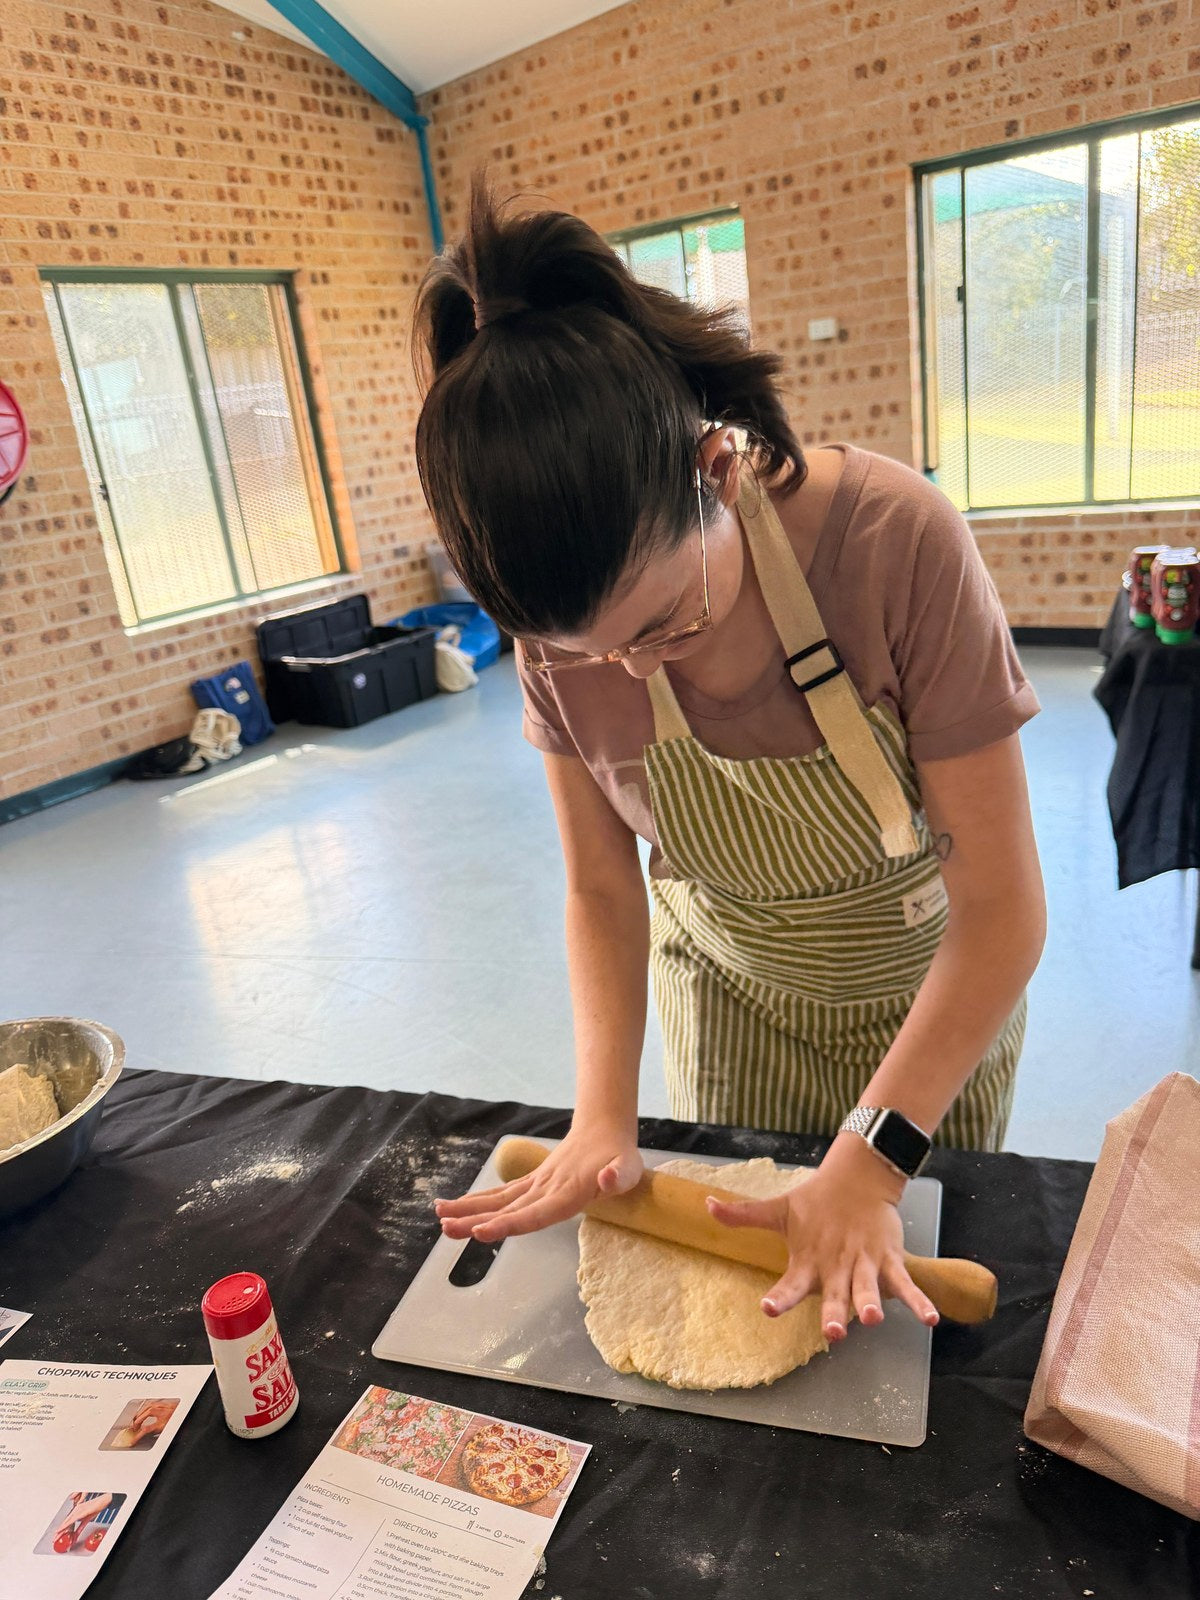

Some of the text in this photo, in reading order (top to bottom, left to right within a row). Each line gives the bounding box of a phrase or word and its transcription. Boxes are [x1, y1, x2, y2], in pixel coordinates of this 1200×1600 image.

[37, 1367, 178, 1381] CHOPPING TECHNIQUES
[304, 1483, 351, 1505] INGREDIENTS
[376, 1475, 481, 1516] HOMEMADE PIZZAS
[333, 1531, 353, 1541] yoghurt
[393, 1518, 438, 1539] DIRECTIONS
[384, 1542, 397, 1550] with
[396, 1546, 415, 1558] baking
[410, 1539, 424, 1549] oven
[469, 1560, 490, 1572] baking
[489, 1568, 504, 1577] trays
[263, 1556, 278, 1565] sauce
[269, 1569, 293, 1581] shredded
[317, 1566, 330, 1575] pizza
[368, 1567, 379, 1576] into
[383, 1572, 395, 1580] ball
[405, 1579, 422, 1587] divide
[373, 1559, 392, 1570] mixing
[392, 1565, 407, 1573] bowl
[406, 1570, 420, 1578] until
[464, 1587, 484, 1597] dough
[402, 1560, 418, 1568] greek
[475, 1581, 491, 1590] large
[386, 1584, 407, 1593] portion
